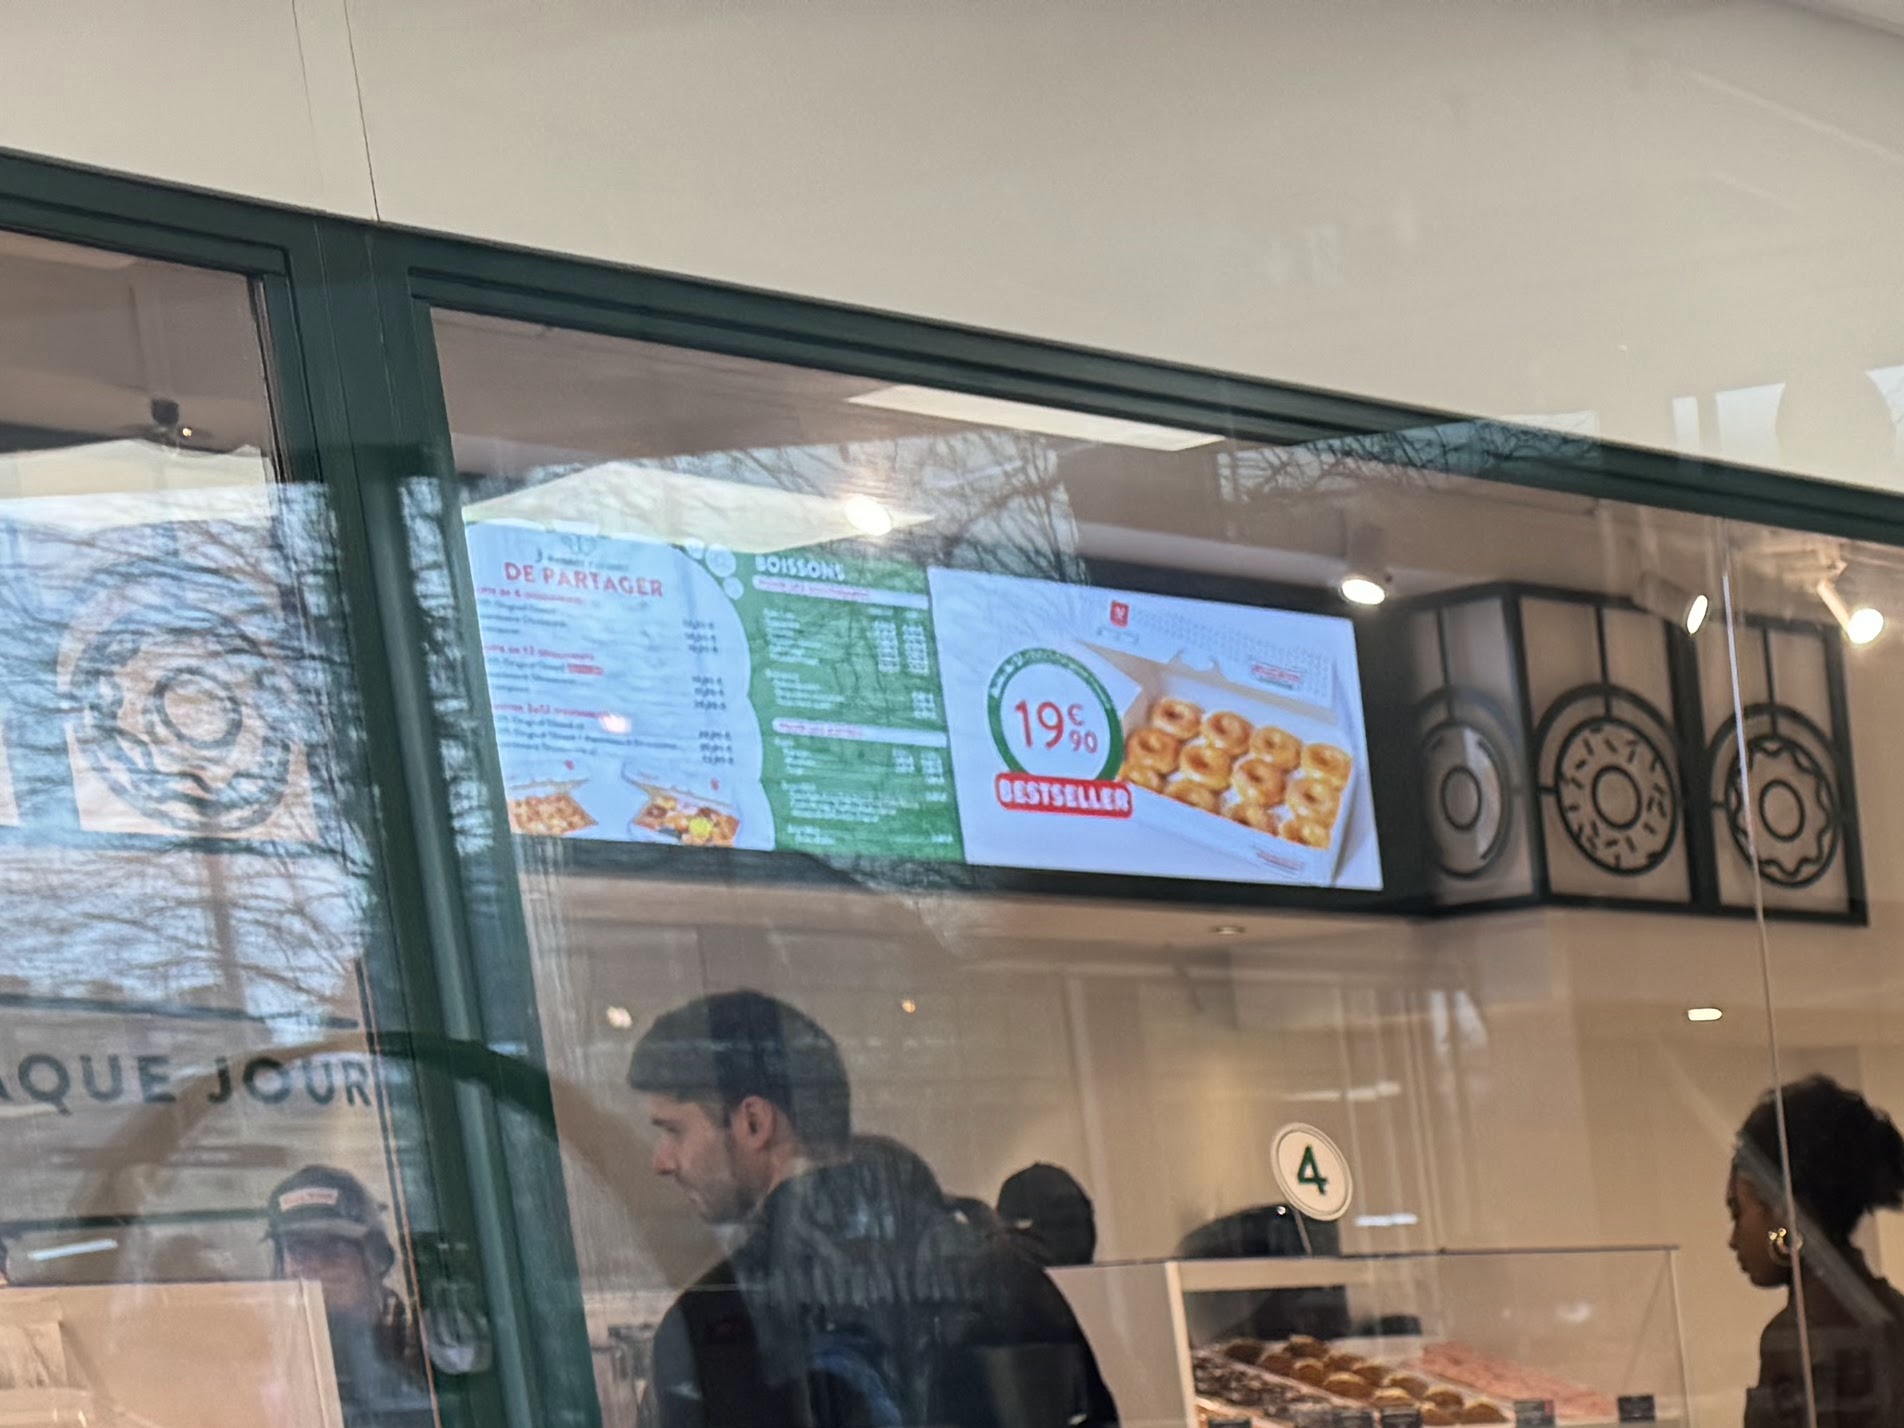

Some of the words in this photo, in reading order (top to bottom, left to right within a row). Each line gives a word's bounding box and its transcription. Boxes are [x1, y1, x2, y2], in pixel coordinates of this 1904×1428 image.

[504, 562, 535, 583] DE
[543, 567, 663, 598] PARTAGER
[1015, 700, 1064, 749] 19
[999, 778, 1130, 811] BESTSELLER
[0, 1053, 176, 1115] QUE
[207, 1056, 371, 1107] JOUR
[1297, 1144, 1328, 1196] 4
